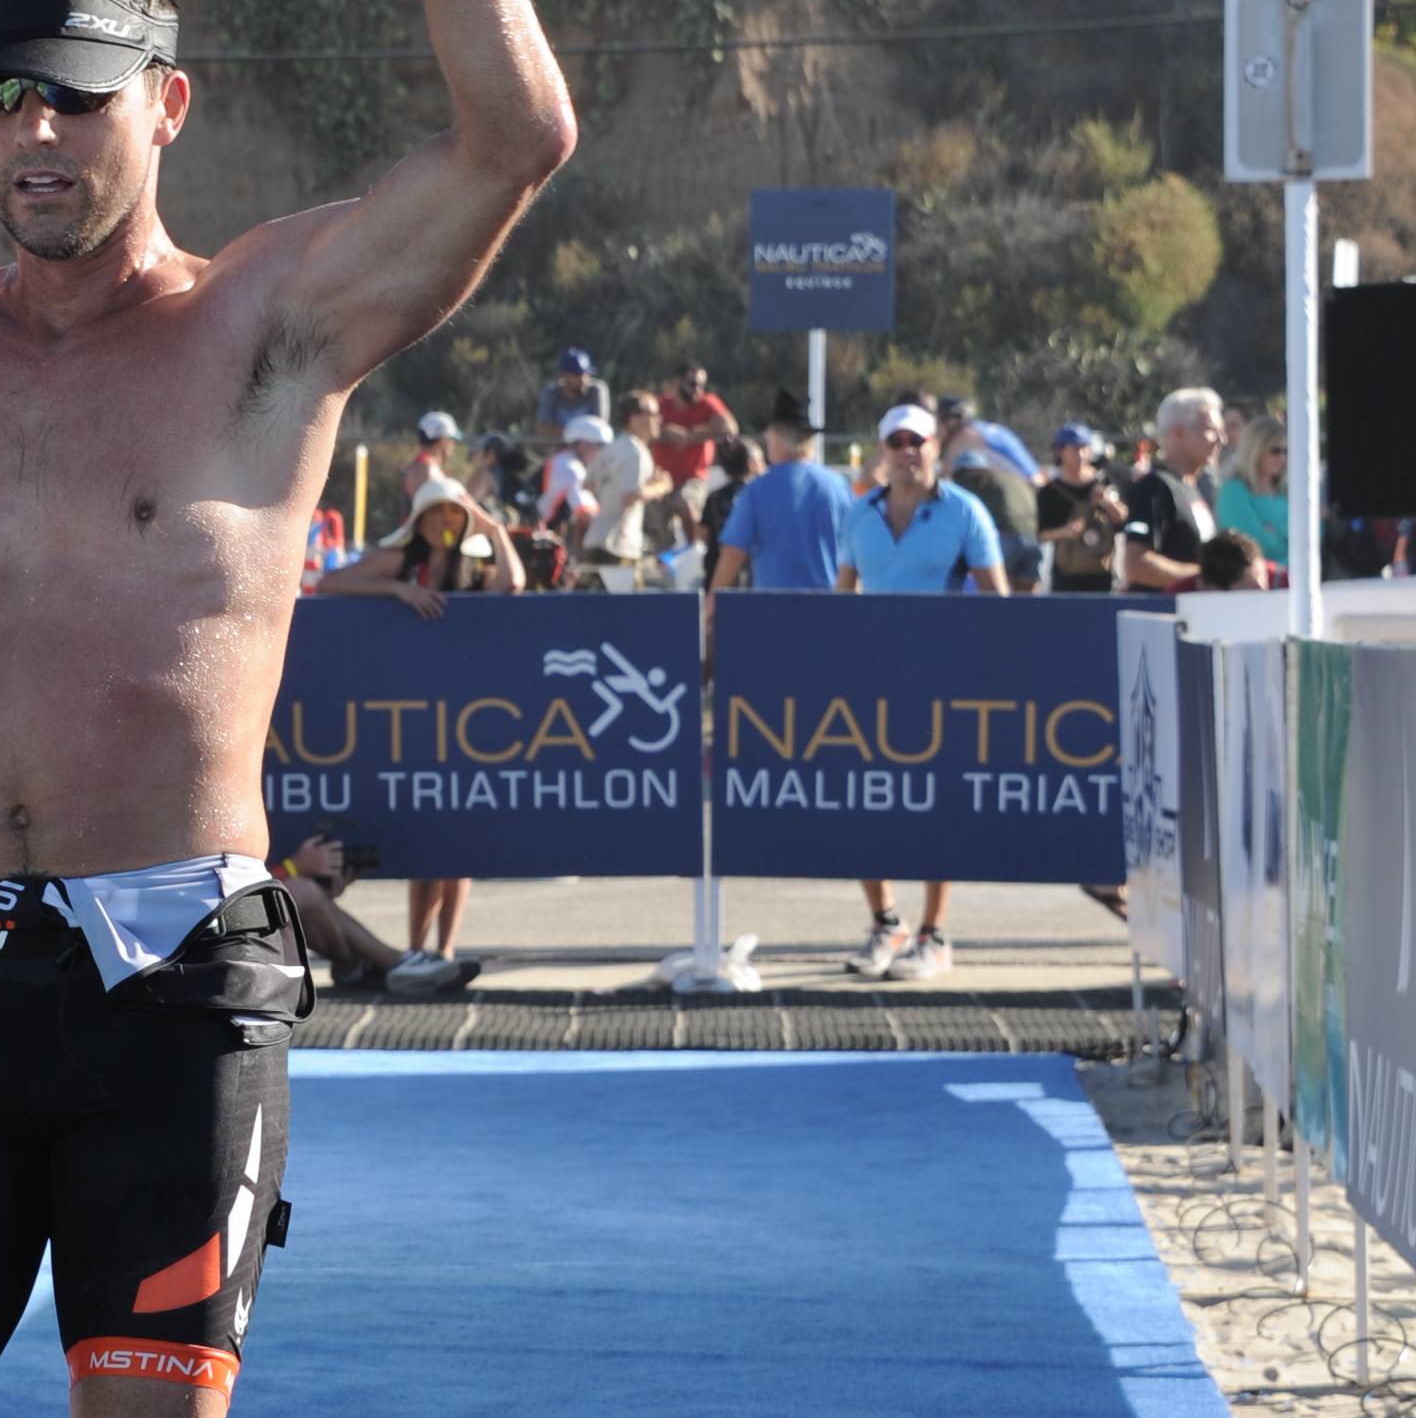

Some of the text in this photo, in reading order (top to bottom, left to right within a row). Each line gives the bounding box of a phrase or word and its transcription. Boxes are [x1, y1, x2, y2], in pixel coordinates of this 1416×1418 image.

[64, 11, 130, 38] 2XU
[754, 242, 865, 263] NAUTICA
[728, 695, 1120, 766] NAUTIC
[378, 769, 677, 812] TRIATHLON
[726, 768, 1118, 815] MALIBU TRIAT
[89, 1350, 214, 1380] MSTINA
